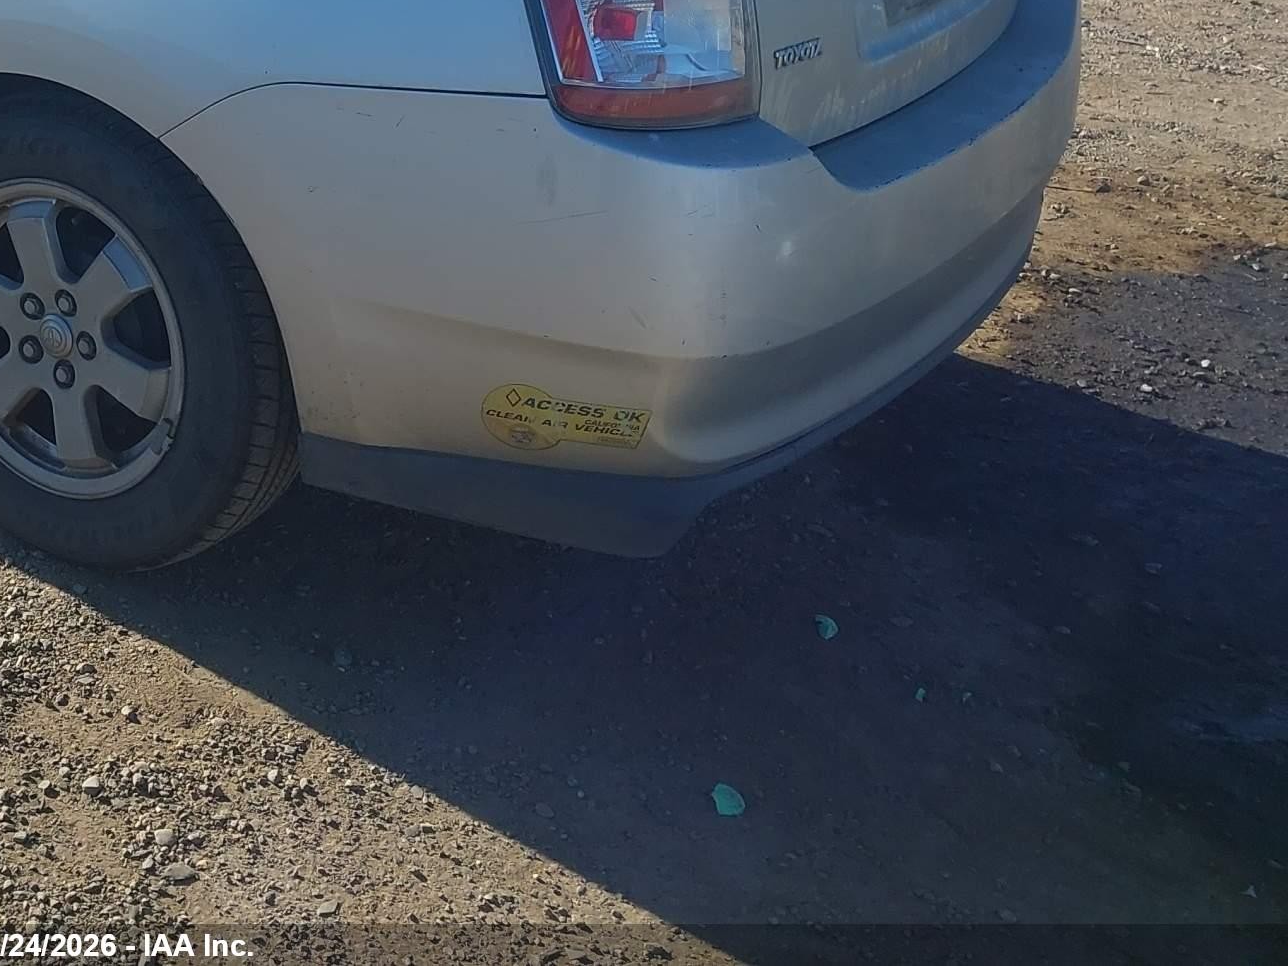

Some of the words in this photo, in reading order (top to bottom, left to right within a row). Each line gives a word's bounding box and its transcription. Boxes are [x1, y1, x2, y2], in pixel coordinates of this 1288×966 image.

[521, 397, 607, 418] ACCESS
[614, 410, 646, 423] OK
[542, 419, 569, 429] AR
